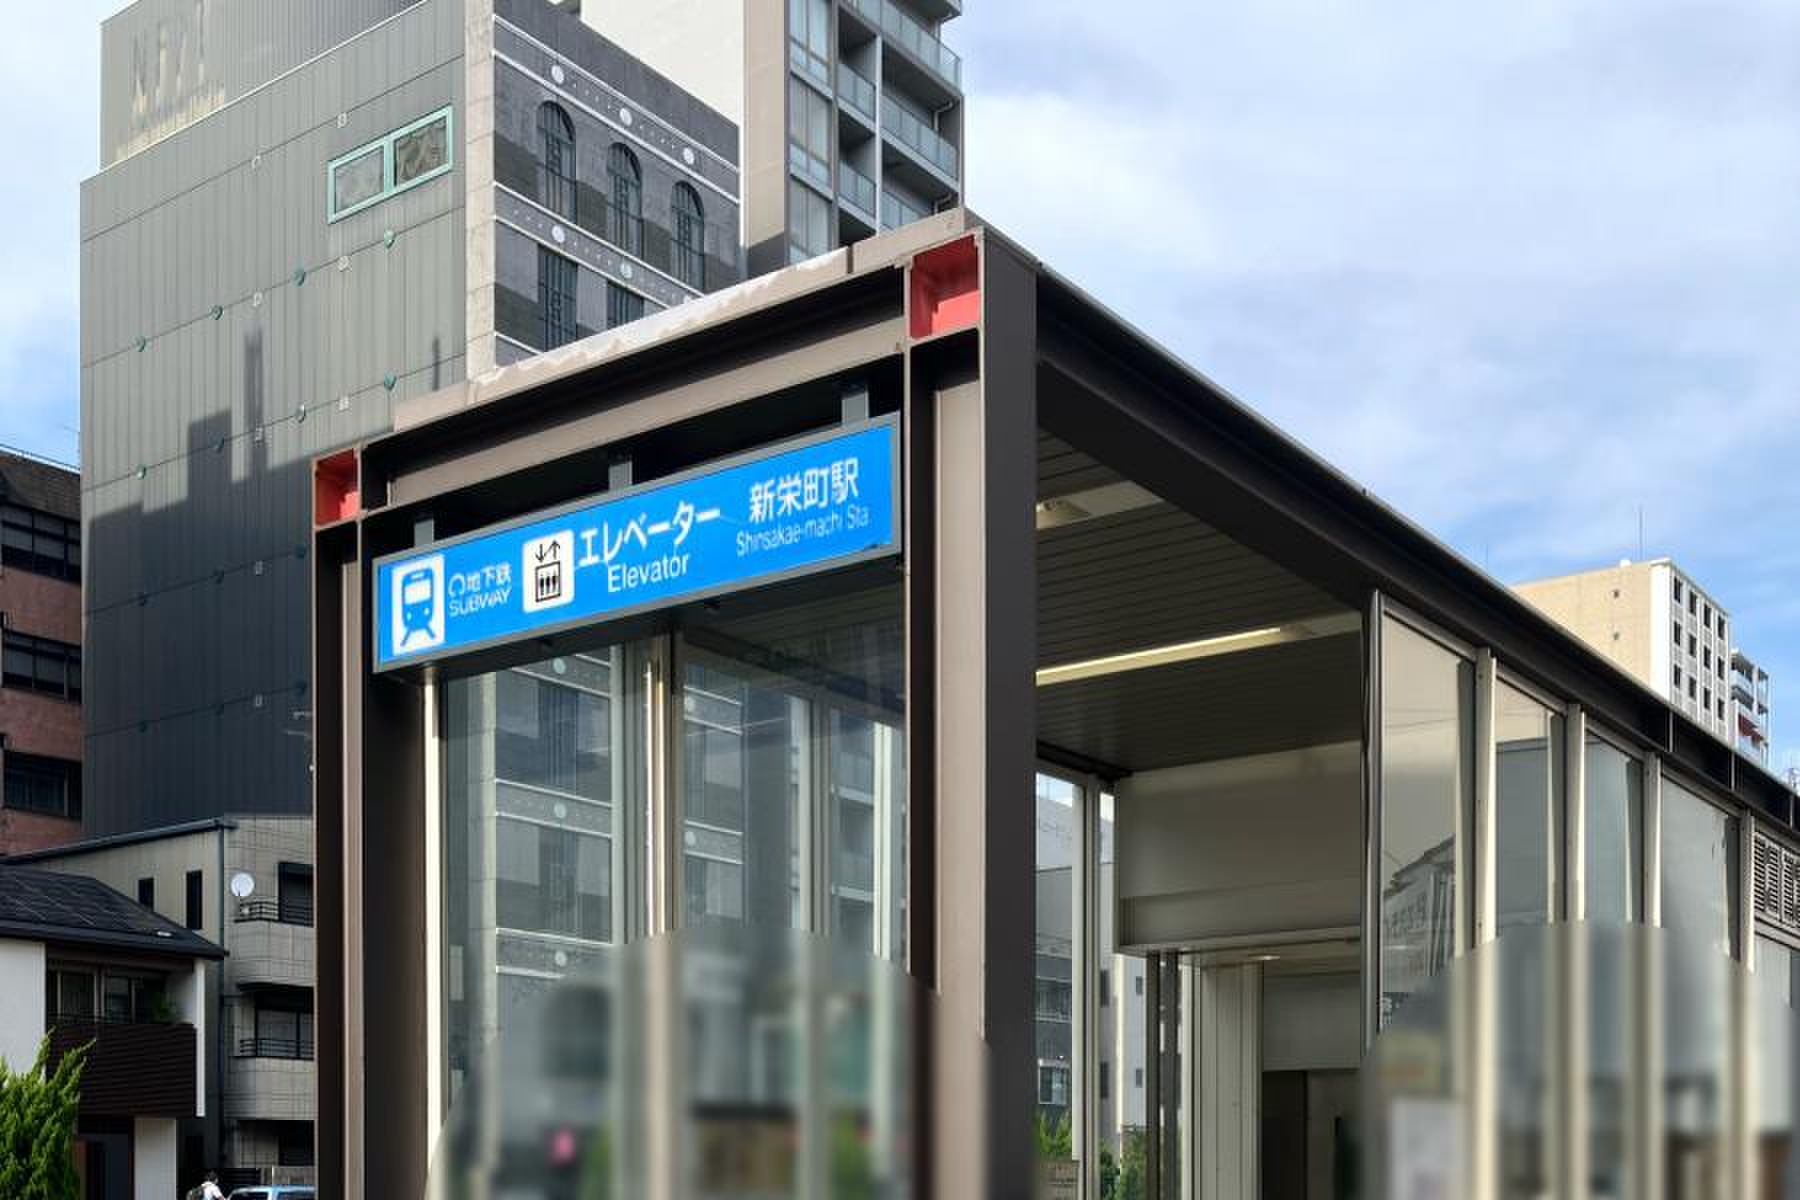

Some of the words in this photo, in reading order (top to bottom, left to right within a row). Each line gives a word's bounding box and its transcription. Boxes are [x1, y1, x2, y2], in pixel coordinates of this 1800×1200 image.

[749, 457, 859, 524] 新栄町駅
[579, 500, 721, 566] エレベーター
[467, 562, 512, 593] 地下鉄
[607, 553, 689, 593] Elevator
[449, 588, 513, 617] SUBWAY
